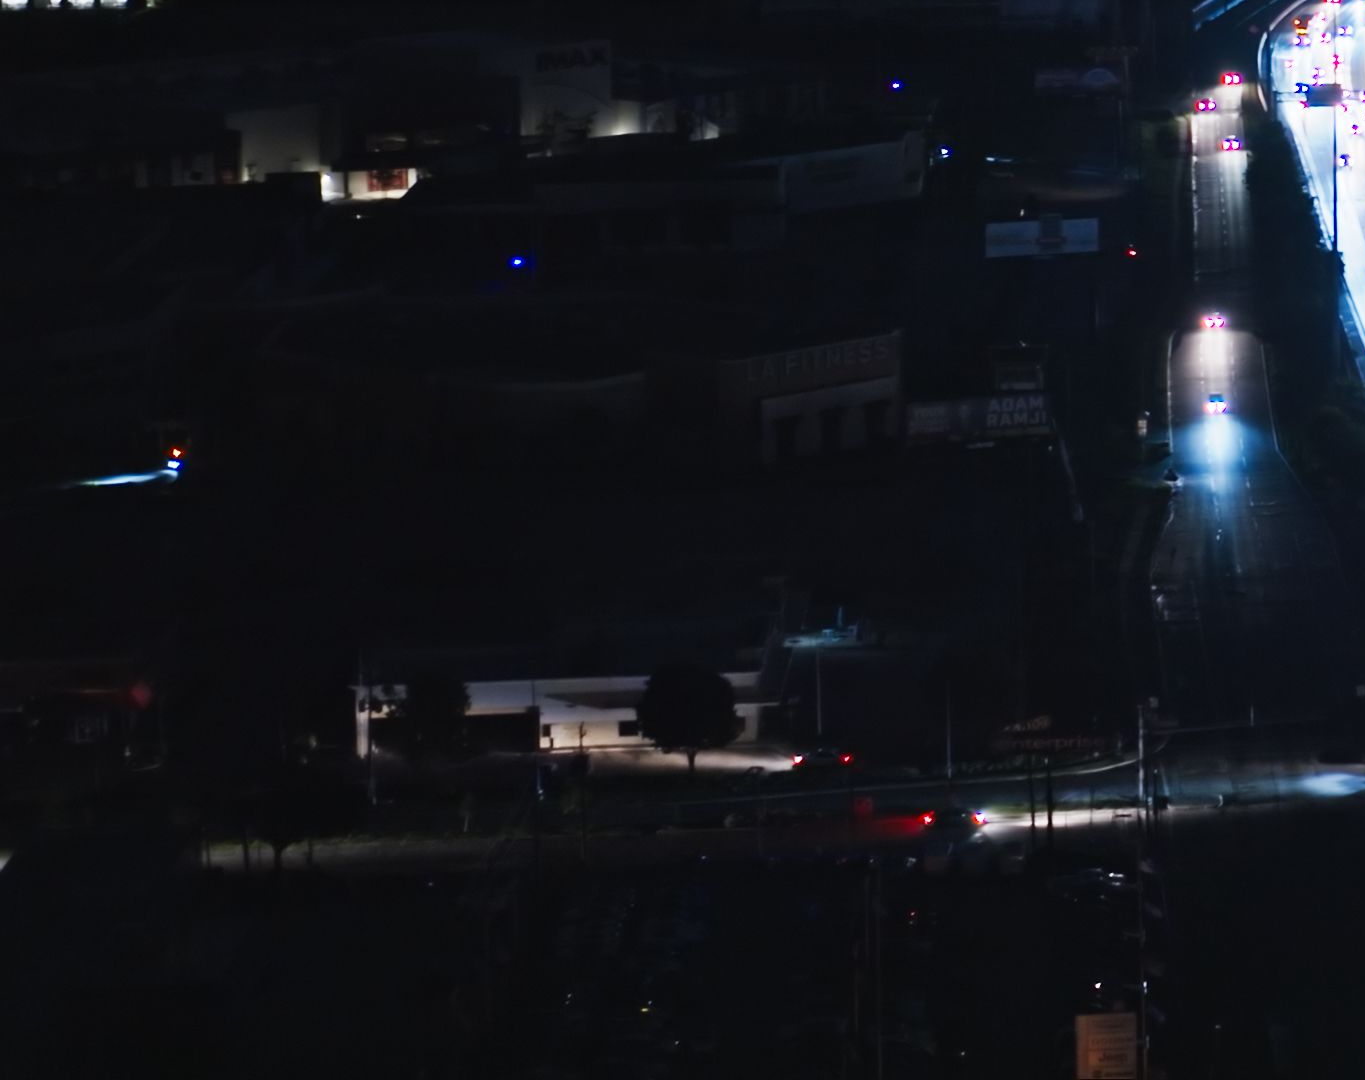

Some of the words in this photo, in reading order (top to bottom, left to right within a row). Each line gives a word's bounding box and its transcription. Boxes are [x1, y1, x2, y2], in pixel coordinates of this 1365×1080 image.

[536, 47, 609, 71] IMAX
[746, 359, 776, 382] LA
[785, 342, 888, 375] FITNESS
[989, 396, 1044, 413] ADAM
[986, 411, 1047, 428] RAMJI
